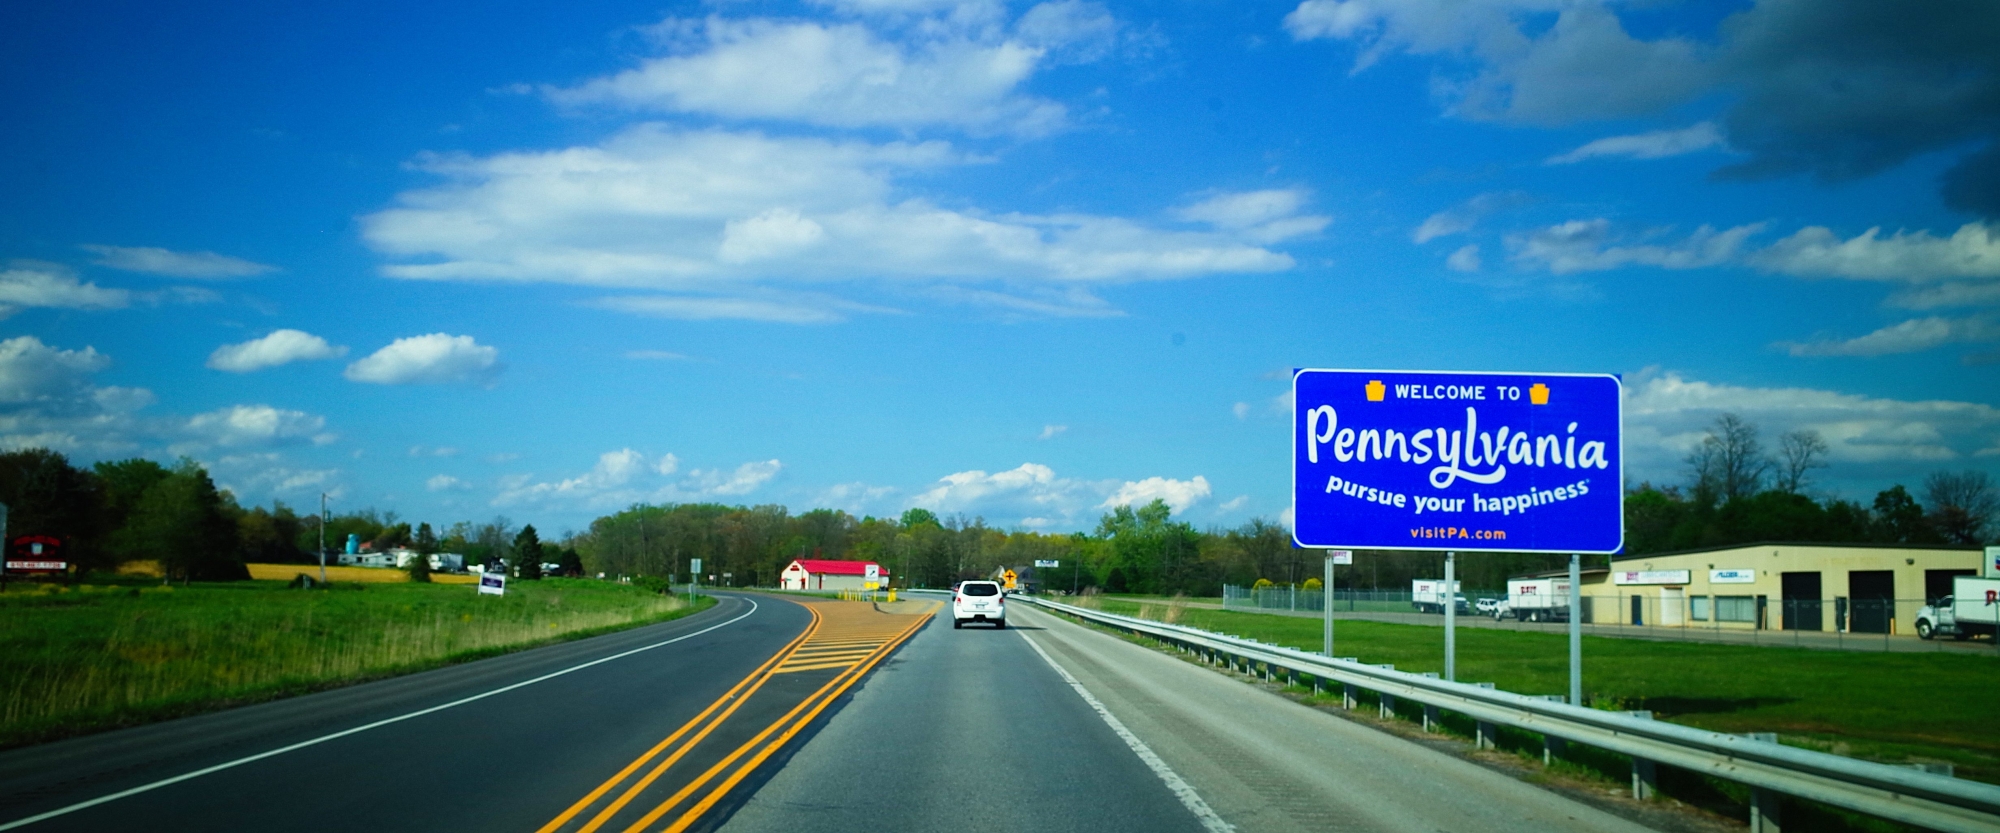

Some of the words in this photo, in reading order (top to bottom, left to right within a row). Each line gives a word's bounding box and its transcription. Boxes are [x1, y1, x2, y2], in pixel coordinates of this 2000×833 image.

[1395, 384, 1486, 400] WELCOME
[1496, 386, 1521, 400] TO
[1307, 404, 1609, 489] Pennsylvania
[1325, 475, 1406, 508] pursue
[1413, 494, 1466, 515] your
[1473, 478, 1589, 516] happiness
[1410, 526, 1507, 540] visitPA.com
